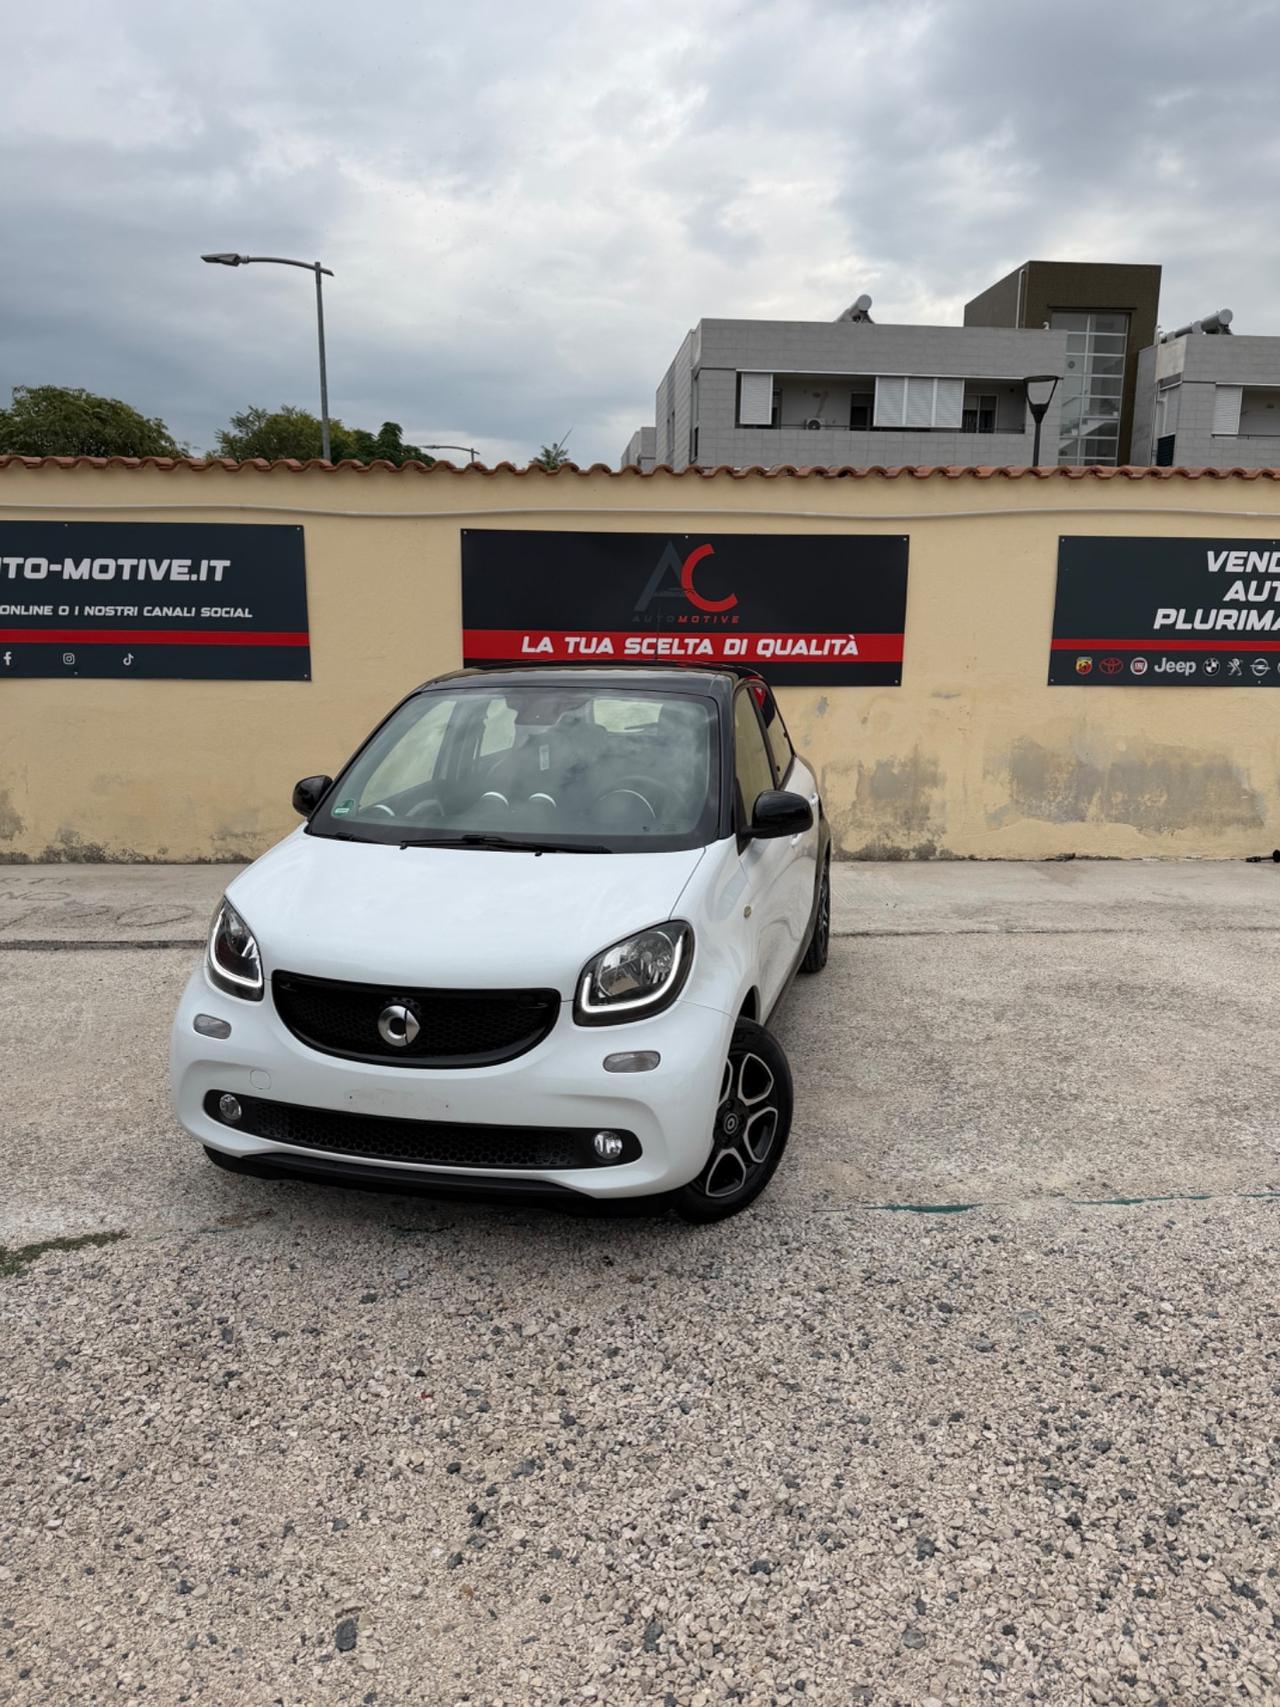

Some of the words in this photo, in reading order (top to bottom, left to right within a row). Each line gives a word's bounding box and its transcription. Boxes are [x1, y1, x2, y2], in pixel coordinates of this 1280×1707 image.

[0, 557, 231, 582] TO-MOTIVE.IT
[1207, 550, 1280, 573] VEND
[0, 604, 53, 616] ONLINE
[58, 605, 70, 616] O
[74, 605, 79, 616] I
[84, 605, 138, 617] NOSTRI
[143, 606, 196, 617] CANALI
[200, 607, 253, 618] SOCIAL
[631, 615, 740, 624] AUTOMOTIVE
[521, 636, 554, 654] LA
[565, 636, 614, 654] TUA
[624, 637, 713, 656] SCELTA
[723, 638, 748, 655] DI
[756, 635, 859, 657] QUALITÀ
[1154, 657, 1197, 676] Jeep
